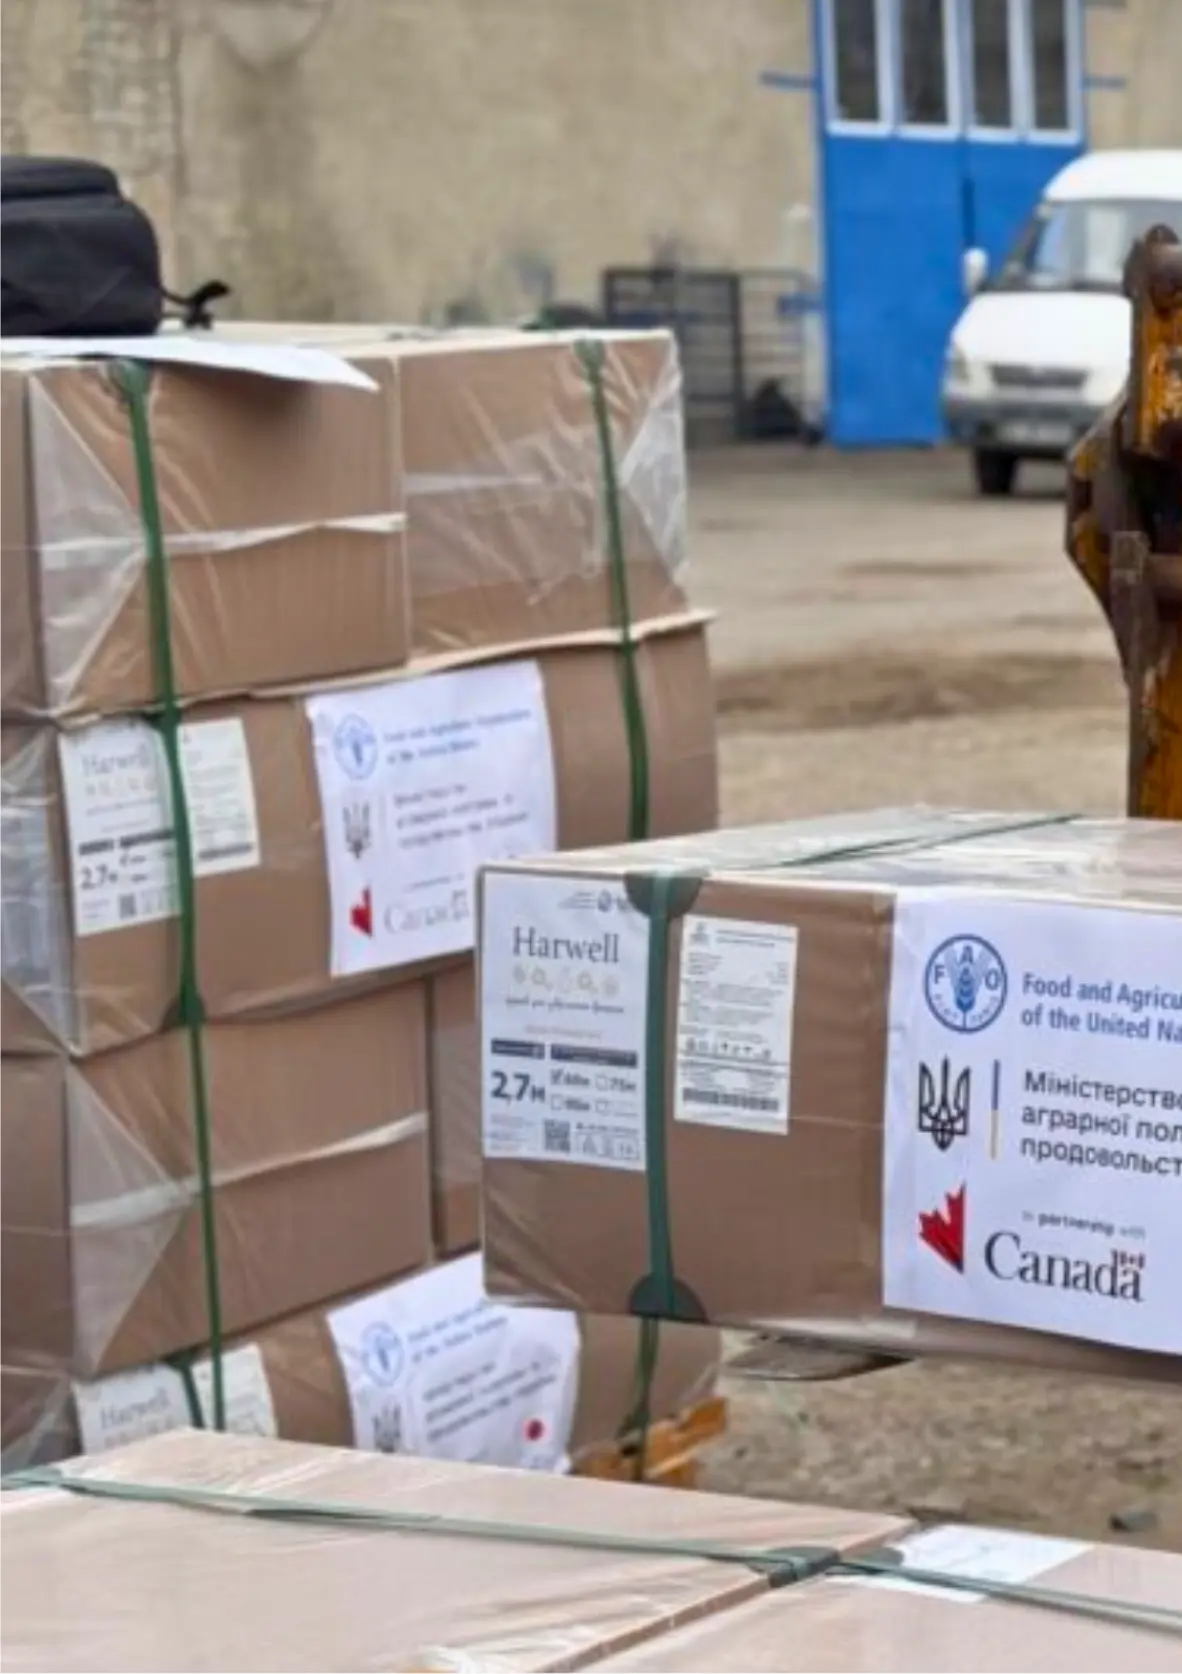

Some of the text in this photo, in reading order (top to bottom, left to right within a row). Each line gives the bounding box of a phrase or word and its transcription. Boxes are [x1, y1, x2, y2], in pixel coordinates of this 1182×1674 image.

[511, 925, 620, 964] Harwell
[1022, 971, 1072, 999] Food
[1077, 979, 1113, 1004] and
[1021, 1003, 1044, 1027] of
[1048, 1006, 1081, 1033] the
[1086, 1011, 1151, 1040] United
[1021, 1105, 1129, 1136] аграрної
[984, 1228, 1147, 1303] Canada
